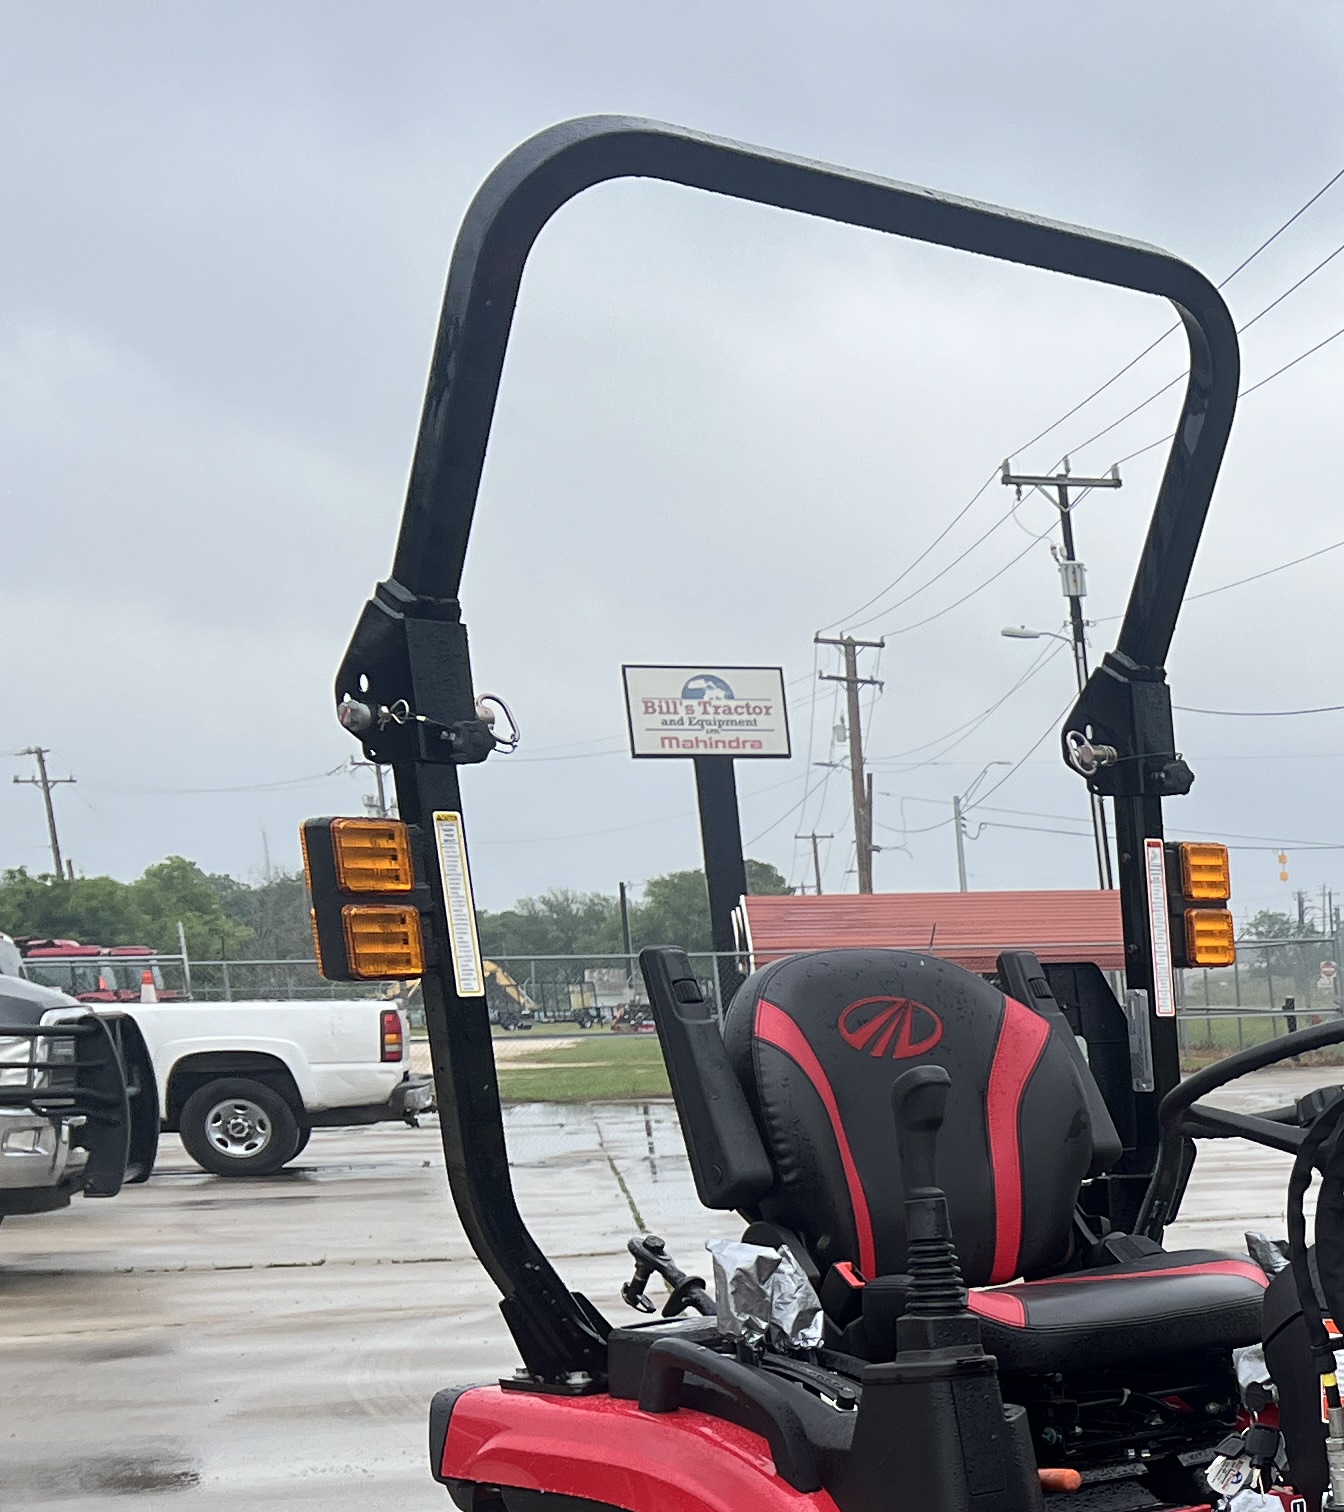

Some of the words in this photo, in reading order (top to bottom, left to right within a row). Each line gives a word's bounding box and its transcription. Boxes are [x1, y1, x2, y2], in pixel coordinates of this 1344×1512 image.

[642, 699, 695, 715] Bill's
[698, 700, 773, 716] Tractor
[661, 717, 685, 726] and
[687, 717, 758, 729] Equipment
